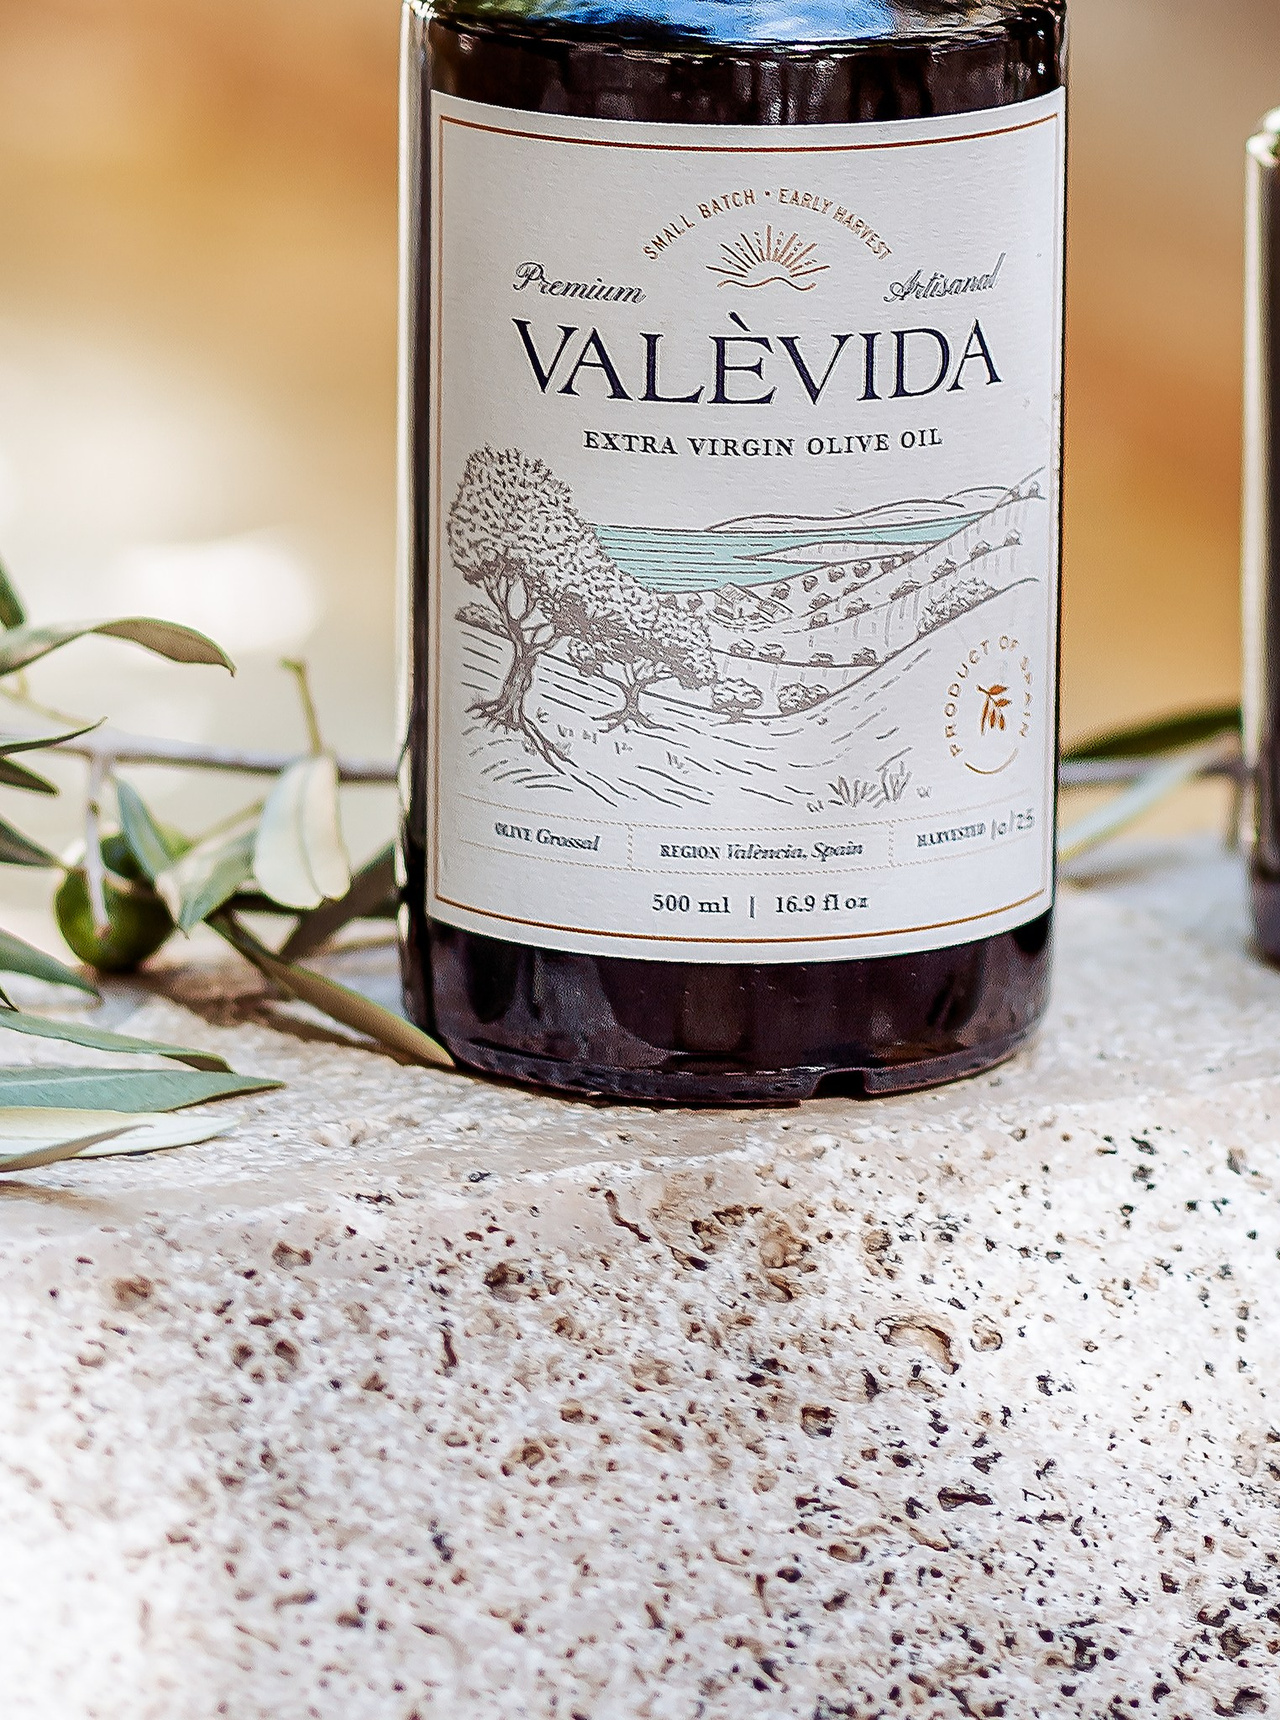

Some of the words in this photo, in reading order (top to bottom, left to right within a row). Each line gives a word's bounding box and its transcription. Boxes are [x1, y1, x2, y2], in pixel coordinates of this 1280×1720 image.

[642, 214, 695, 260] SMALL
[696, 188, 756, 219] BATCH
[779, 188, 833, 214] EARLY
[832, 206, 892, 260] HARVEST
[513, 261, 646, 303] Premium
[884, 252, 1006, 304] Artisanal
[511, 311, 1004, 406] VALÈVIDA
[584, 430, 674, 455] EXTRA
[687, 437, 796, 457] VIRGIN
[807, 434, 890, 456] OLIVE
[901, 428, 943, 448] OIL
[944, 640, 989, 757] PRODUCT
[659, 843, 720, 859] REGION
[811, 840, 863, 862] Spain
[651, 893, 690, 912] 500
[698, 896, 731, 913] ml
[775, 894, 816, 913] 16.9
[823, 893, 840, 911] fl
[845, 895, 869, 910] oz
